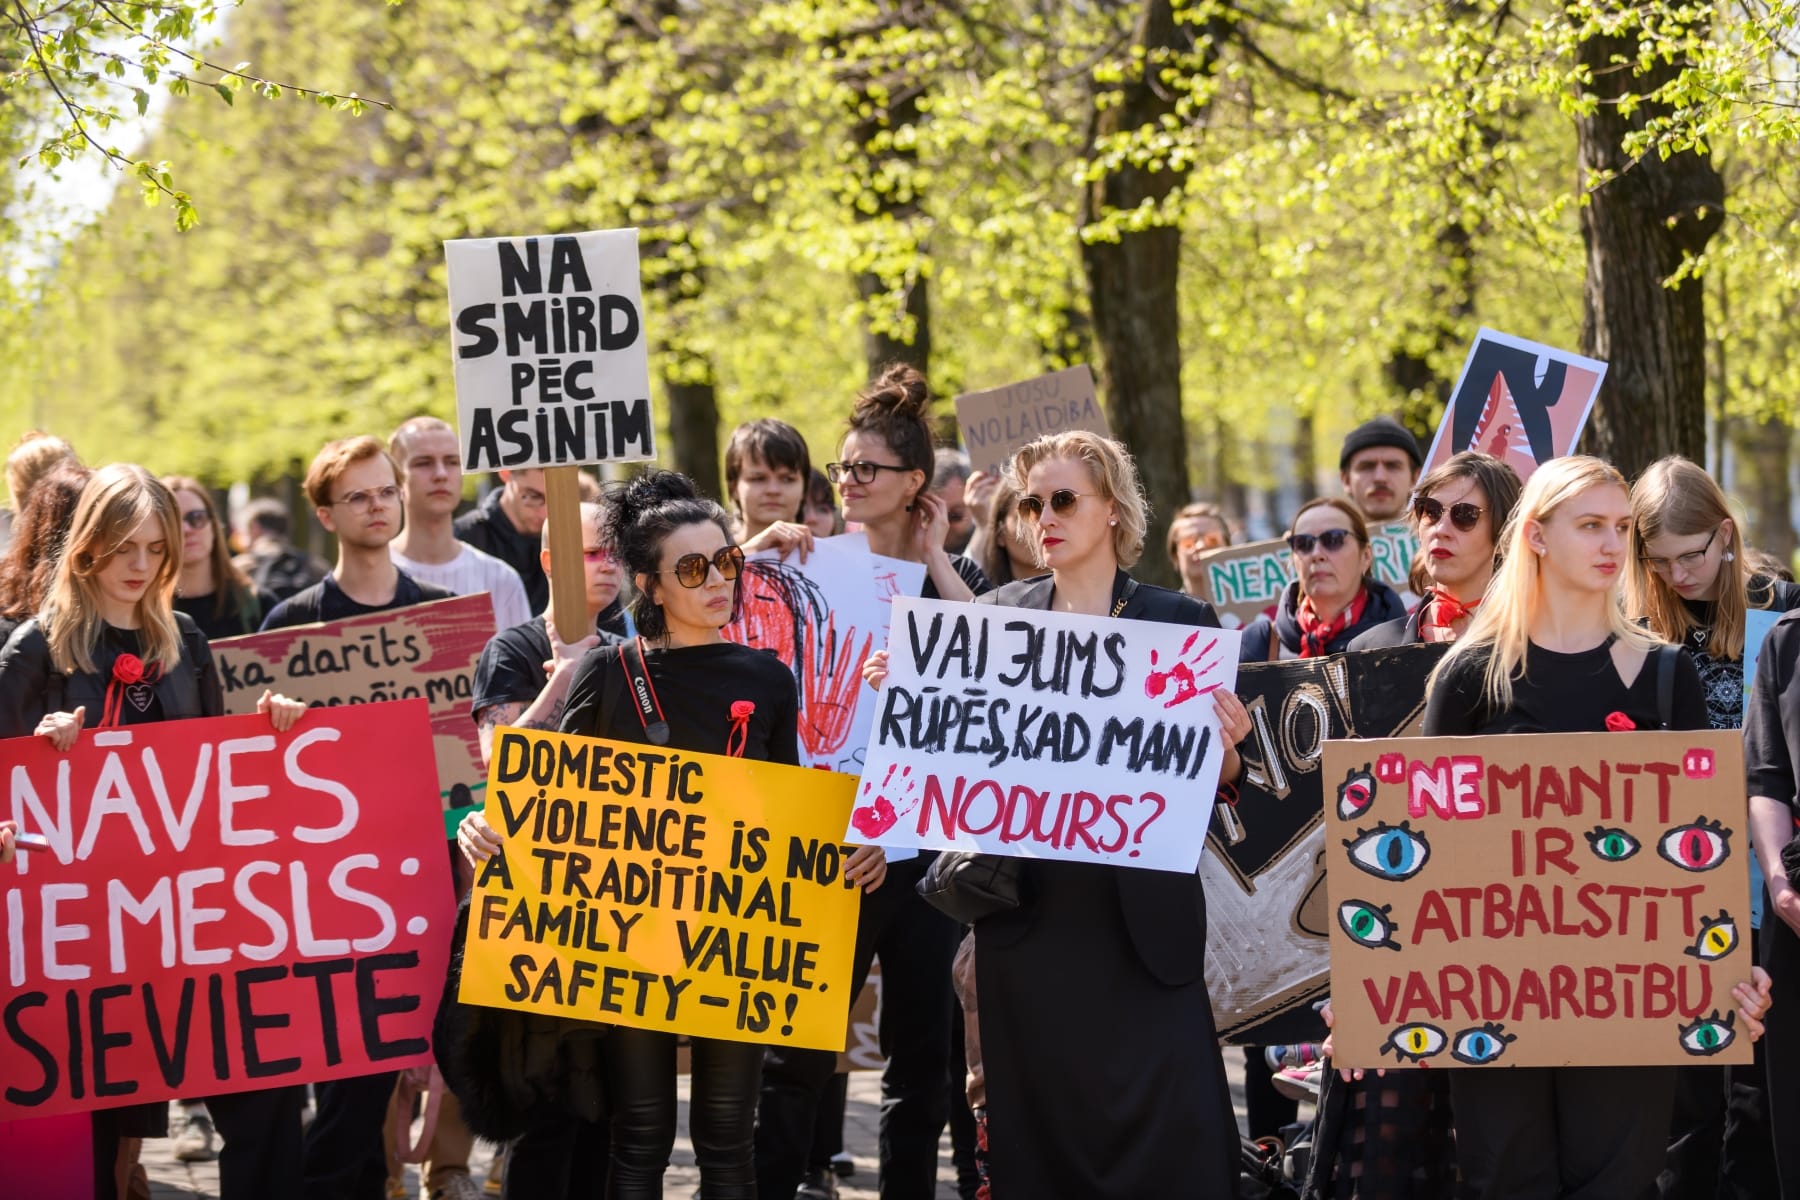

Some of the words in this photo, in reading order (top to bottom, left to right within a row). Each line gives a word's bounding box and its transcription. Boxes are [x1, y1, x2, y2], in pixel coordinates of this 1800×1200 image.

[498, 237, 592, 296] NA
[511, 359, 595, 405] PĒC
[287, 626, 420, 678] darīts
[907, 610, 988, 682] VAI
[634, 676, 653, 714] Canon
[1096, 716, 1211, 780] MANI
[11, 728, 359, 874] NĀVES
[915, 774, 1167, 858] NODURS?
[478, 845, 513, 890] A
[1511, 826, 1580, 879] IR
[7, 854, 428, 986] IEMESLS:
[1411, 882, 1706, 945] ATBALSTĪT
[676, 920, 828, 992] VALUE.
[1362, 963, 1713, 1026] VARDARBĪBU
[4, 950, 429, 1106] SIEVIETE
